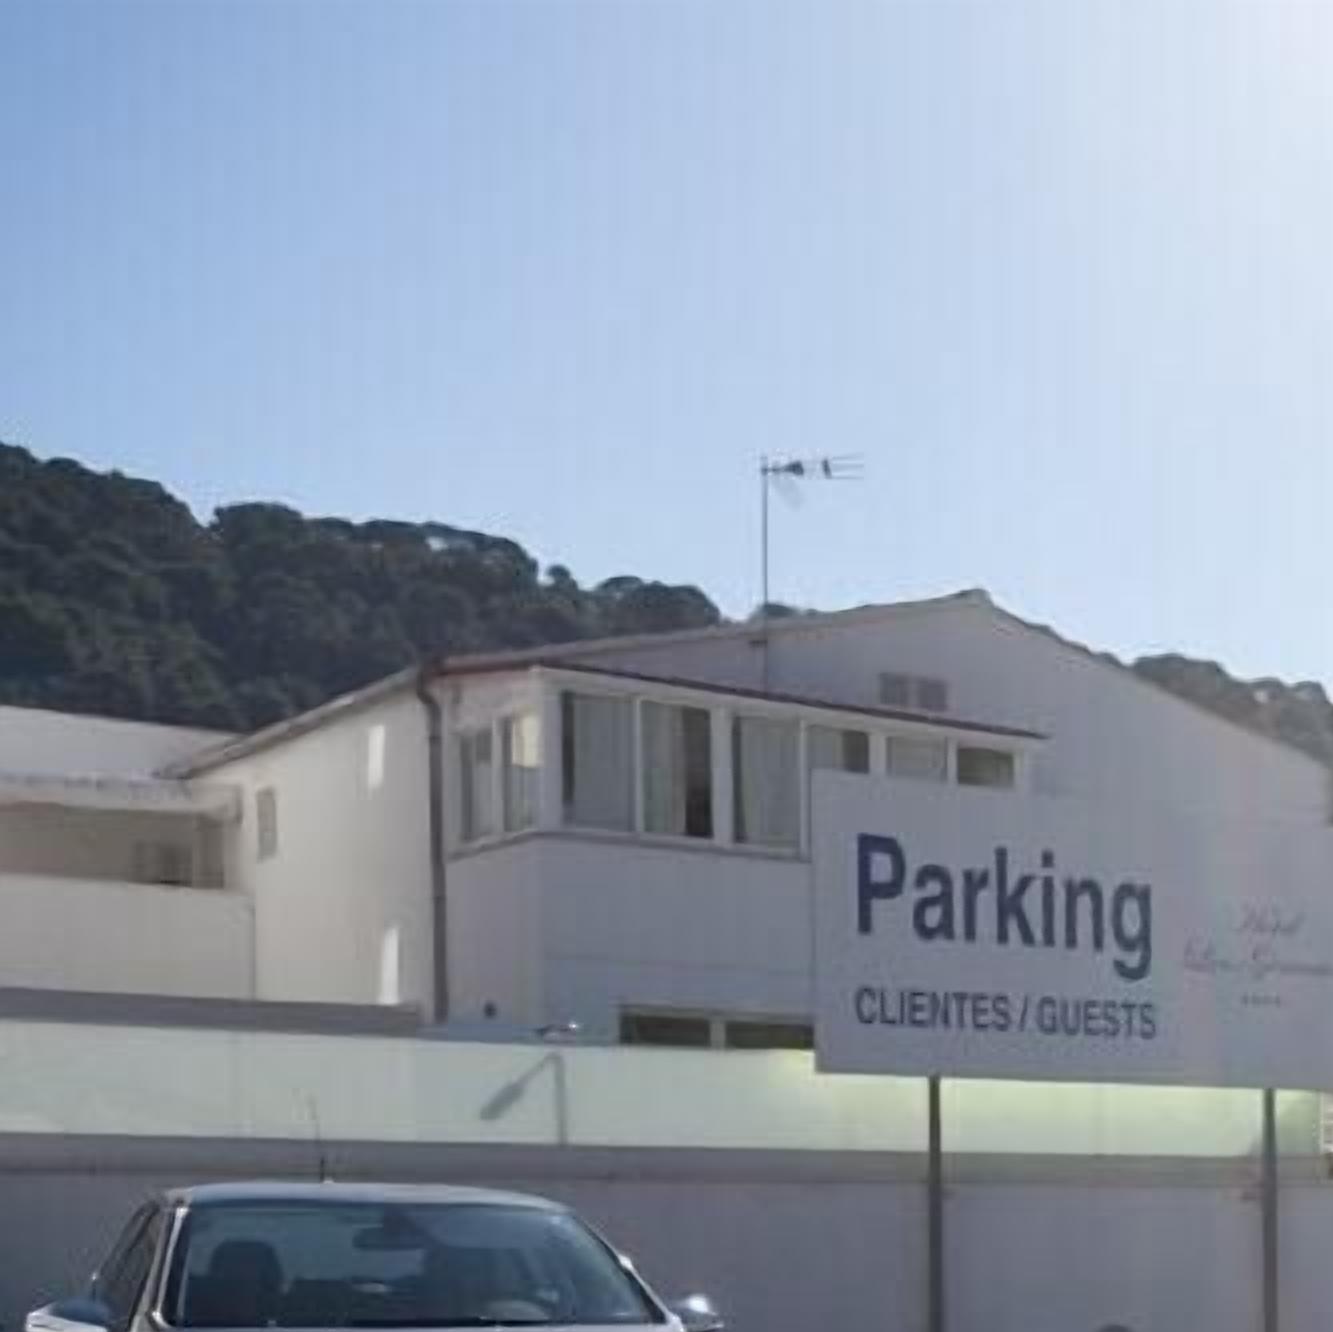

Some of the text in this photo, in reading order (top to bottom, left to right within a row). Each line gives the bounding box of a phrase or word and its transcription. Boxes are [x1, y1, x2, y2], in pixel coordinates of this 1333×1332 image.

[856, 833, 1153, 981] Parking
[855, 986, 1010, 1031] CLIENTES
[1037, 996, 1156, 1040] GUESTS
